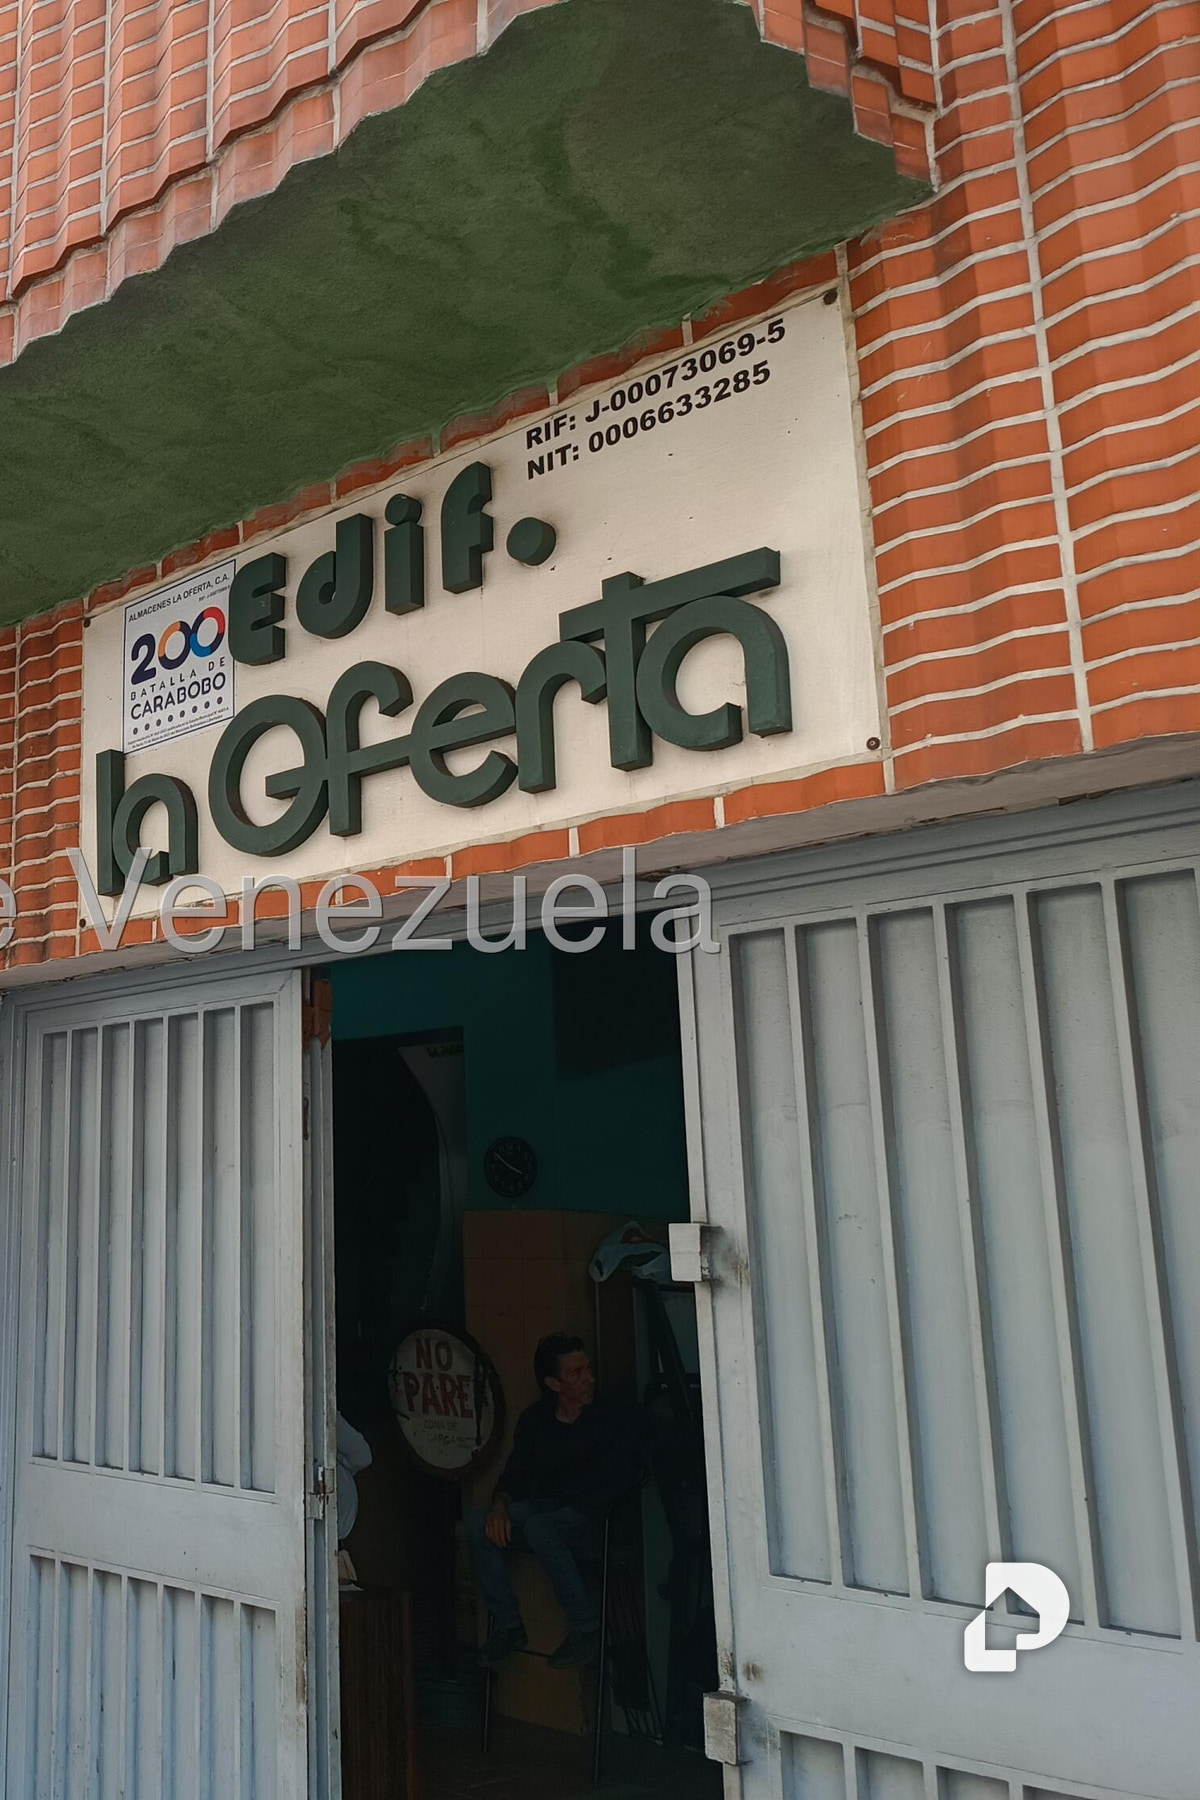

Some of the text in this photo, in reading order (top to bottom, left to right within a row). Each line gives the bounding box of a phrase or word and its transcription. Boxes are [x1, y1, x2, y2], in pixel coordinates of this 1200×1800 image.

[526, 318, 786, 450] RIF: J-00073069-5
[527, 360, 771, 480] NIT: 0006633285
[228, 461, 556, 666] Edif.
[128, 598, 172, 623] ALMACENES
[172, 594, 182, 604] LA
[131, 606, 226, 686] 200
[131, 656, 226, 701] BATALLA DE
[131, 672, 226, 720] CARABOBO
[415, 1338, 453, 1371] NO
[404, 1371, 474, 1419] PARE
